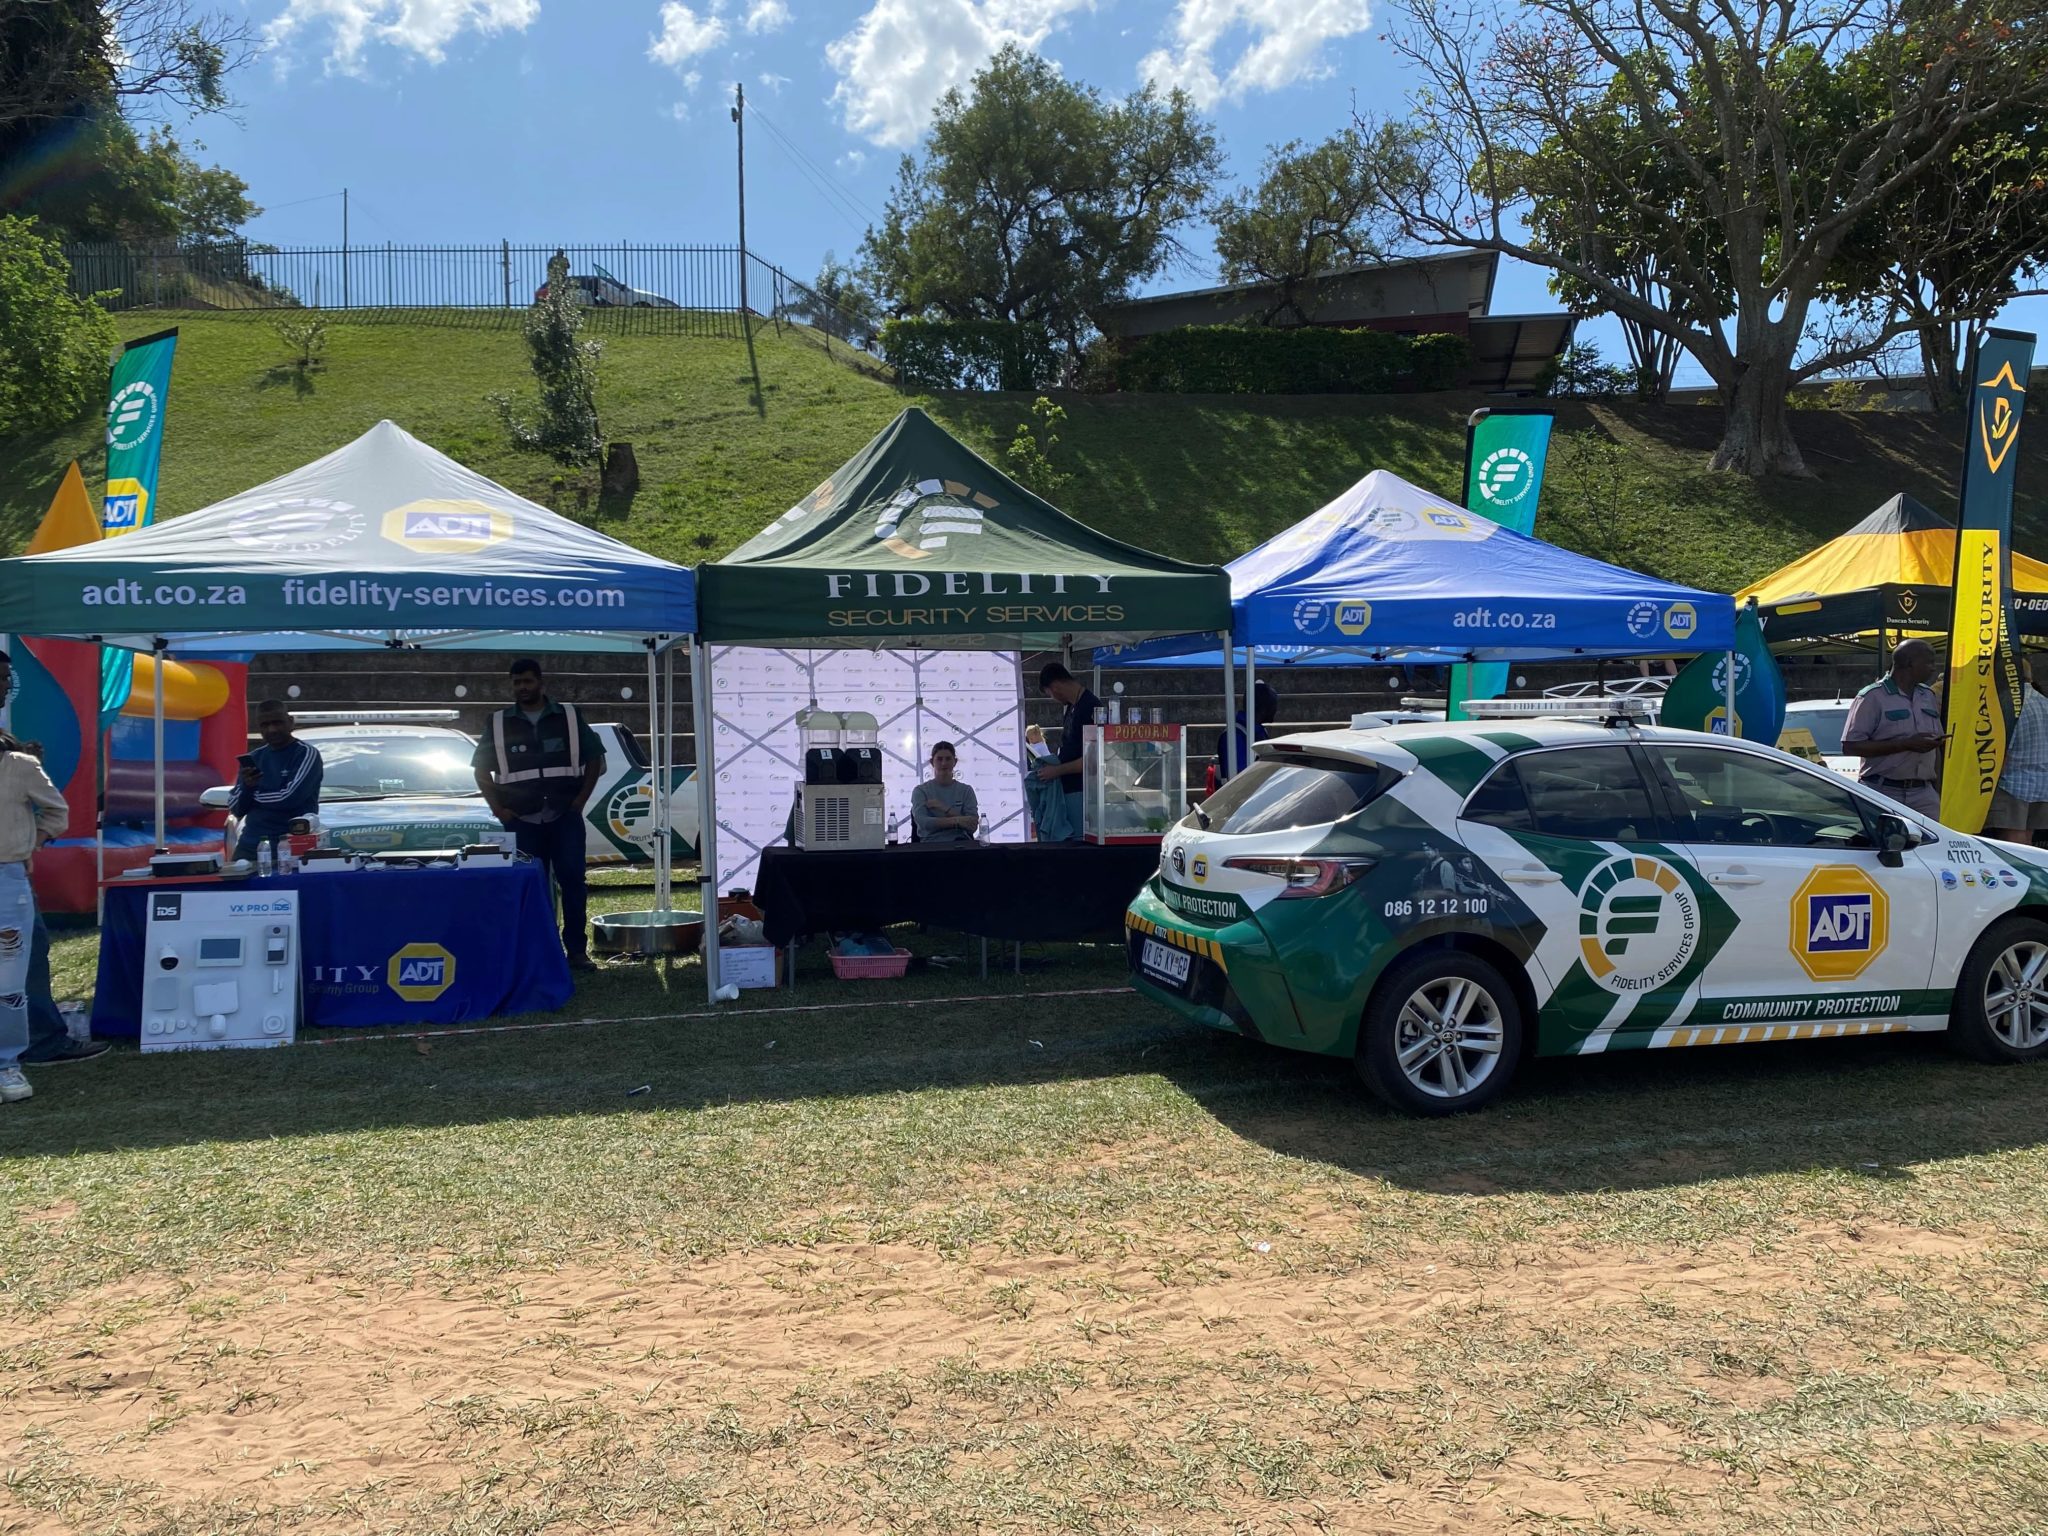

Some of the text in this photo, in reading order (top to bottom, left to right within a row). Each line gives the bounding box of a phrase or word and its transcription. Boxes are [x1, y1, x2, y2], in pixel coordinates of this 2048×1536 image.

[405, 516, 492, 536] ADT
[1432, 514, 1465, 527] ADT
[82, 578, 247, 605] adt.co.za
[824, 571, 1116, 599] FIDELITY
[282, 579, 625, 612] fidelity-services.com
[827, 604, 1126, 627] SECURITY SERVICES
[1340, 609, 1366, 623] ADT
[1452, 606, 1557, 629] adt.co.za
[1669, 612, 1692, 628] ADT
[1886, 616, 1930, 627] Duncan Security
[1974, 541, 1996, 796] DUNCAN SECURITY
[1114, 725, 1169, 739] POPCORN
[332, 822, 491, 838] COMMUNITY PROTECTION
[1947, 850, 1985, 864] 47072
[230, 904, 244, 913] VX
[247, 904, 270, 912] PRO
[1182, 894, 1237, 919] PROTECTION
[1384, 898, 1488, 917] 086 12 12 100
[1809, 904, 1871, 943] ADT
[1611, 892, 1694, 990] FIDELITY SERVICES GROUP
[400, 961, 445, 982] ADT
[344, 983, 380, 994] Group
[1722, 995, 1902, 1020] COMMUNITY PROTECTION
